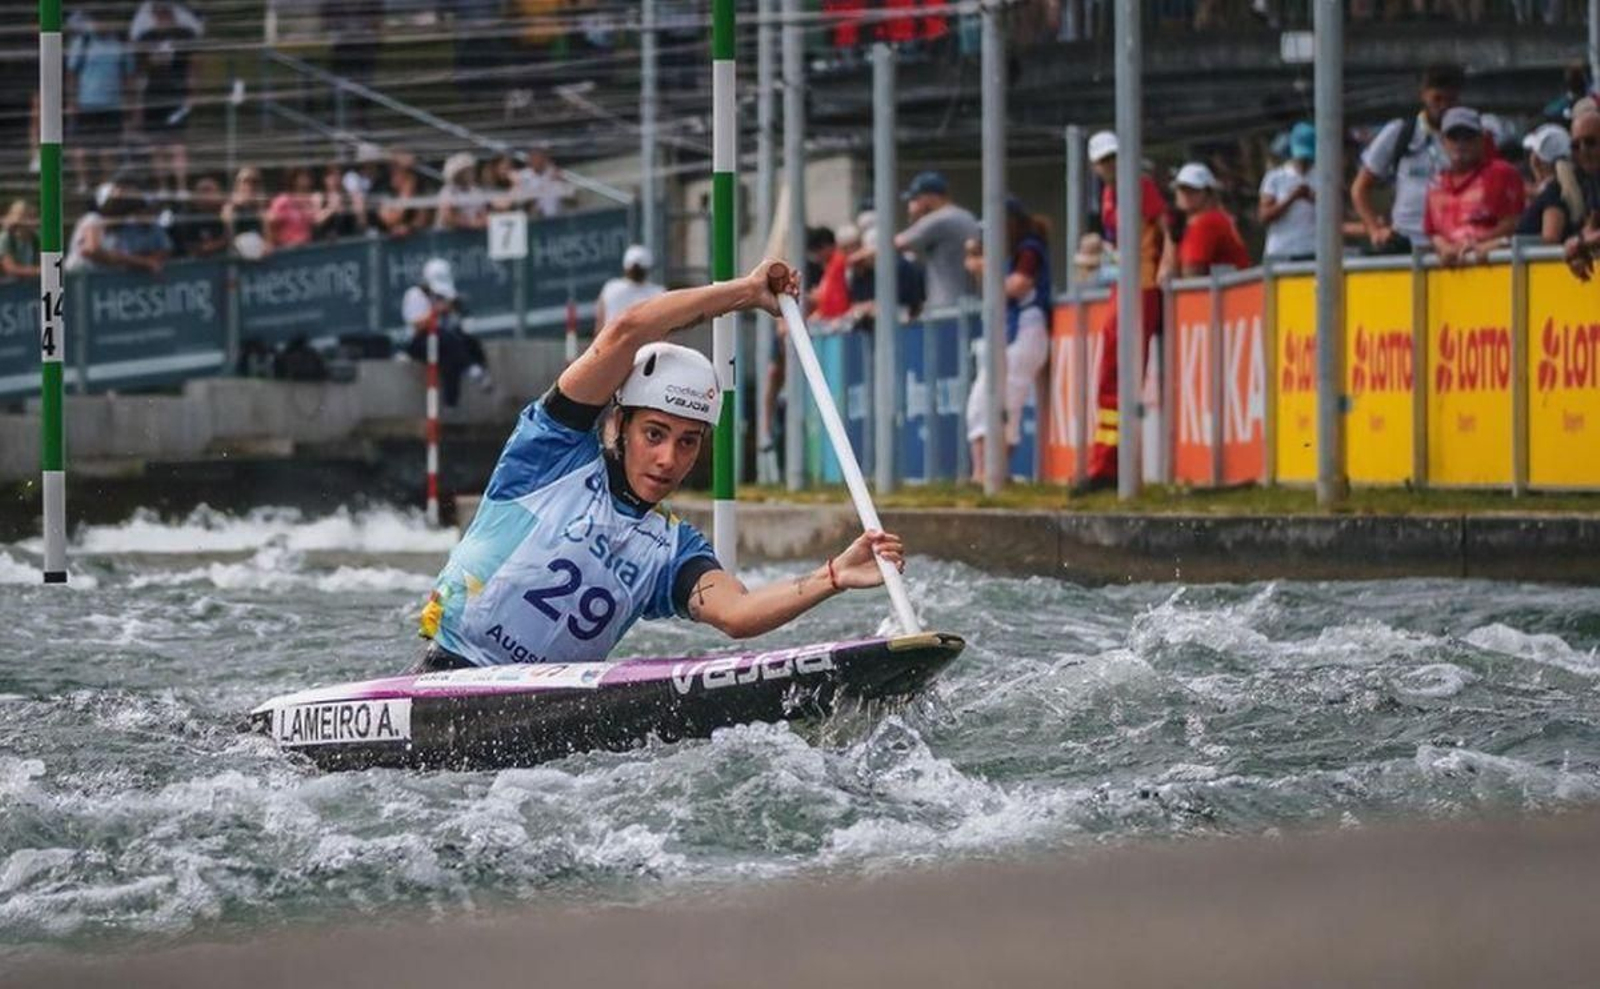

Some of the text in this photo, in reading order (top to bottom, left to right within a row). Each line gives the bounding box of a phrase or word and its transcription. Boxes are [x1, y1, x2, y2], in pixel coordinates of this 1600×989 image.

[499, 219, 516, 251] 7
[93, 279, 215, 324] Hessing
[1457, 327, 1511, 392] LOTTO
[523, 557, 617, 642] 29
[280, 702, 400, 742] LAMEIRO A.
